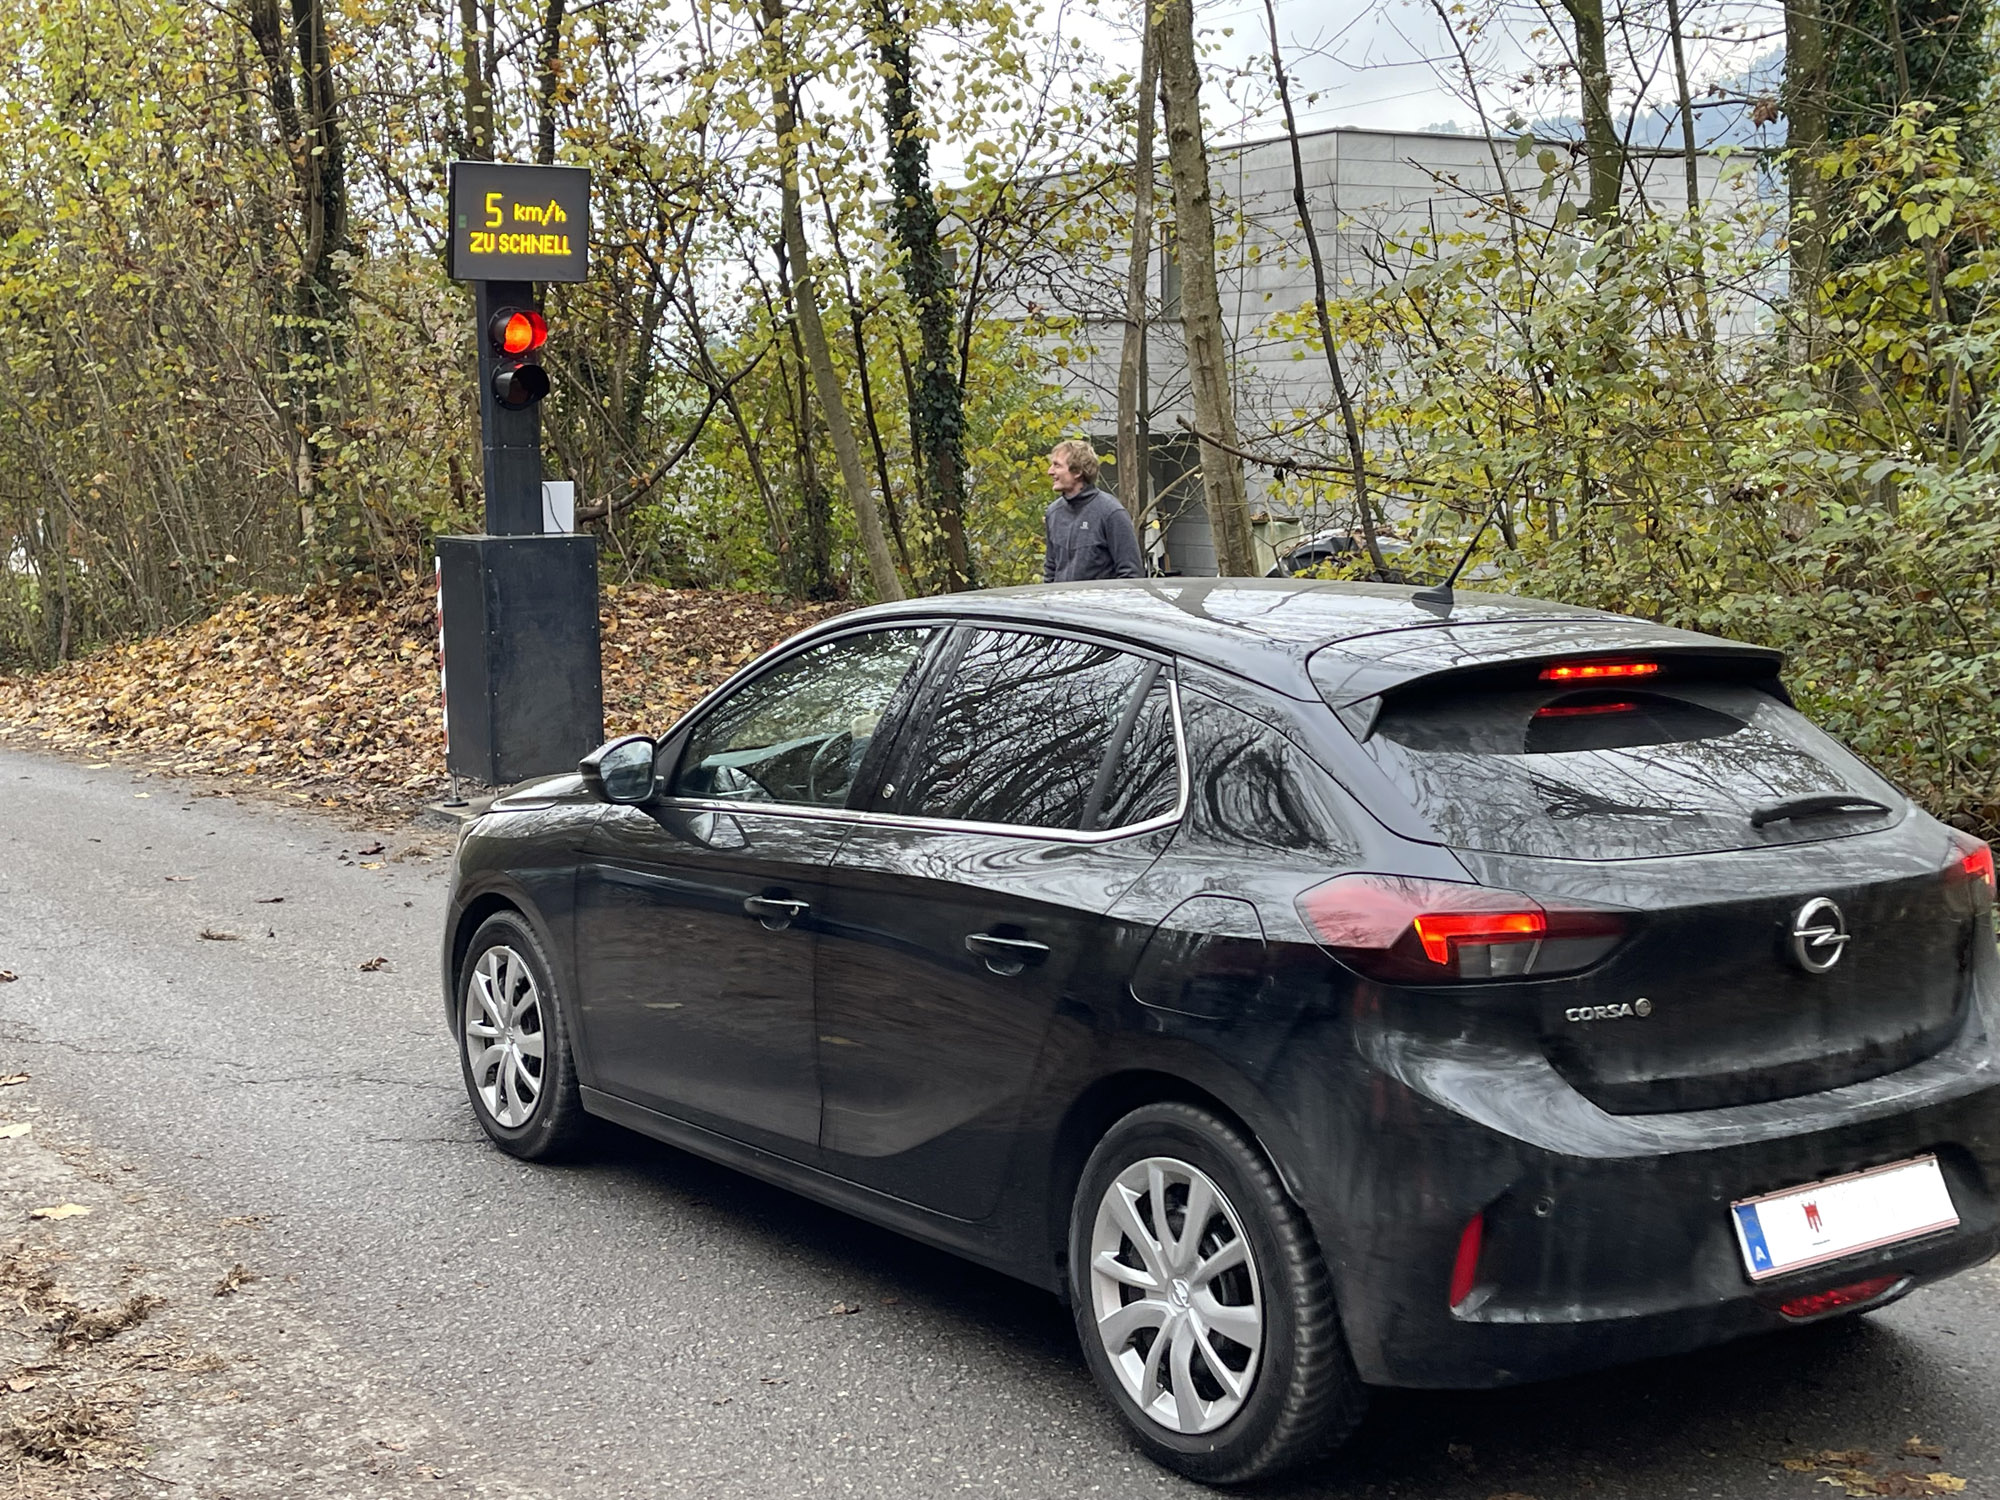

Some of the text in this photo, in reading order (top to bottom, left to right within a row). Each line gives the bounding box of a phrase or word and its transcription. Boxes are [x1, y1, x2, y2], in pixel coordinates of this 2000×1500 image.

[485, 192, 567, 228] 5 km/h
[469, 231, 572, 256] ZU SCHNELL
[1565, 1003, 1634, 1022] CORSA
[1755, 1245, 1767, 1262] A
